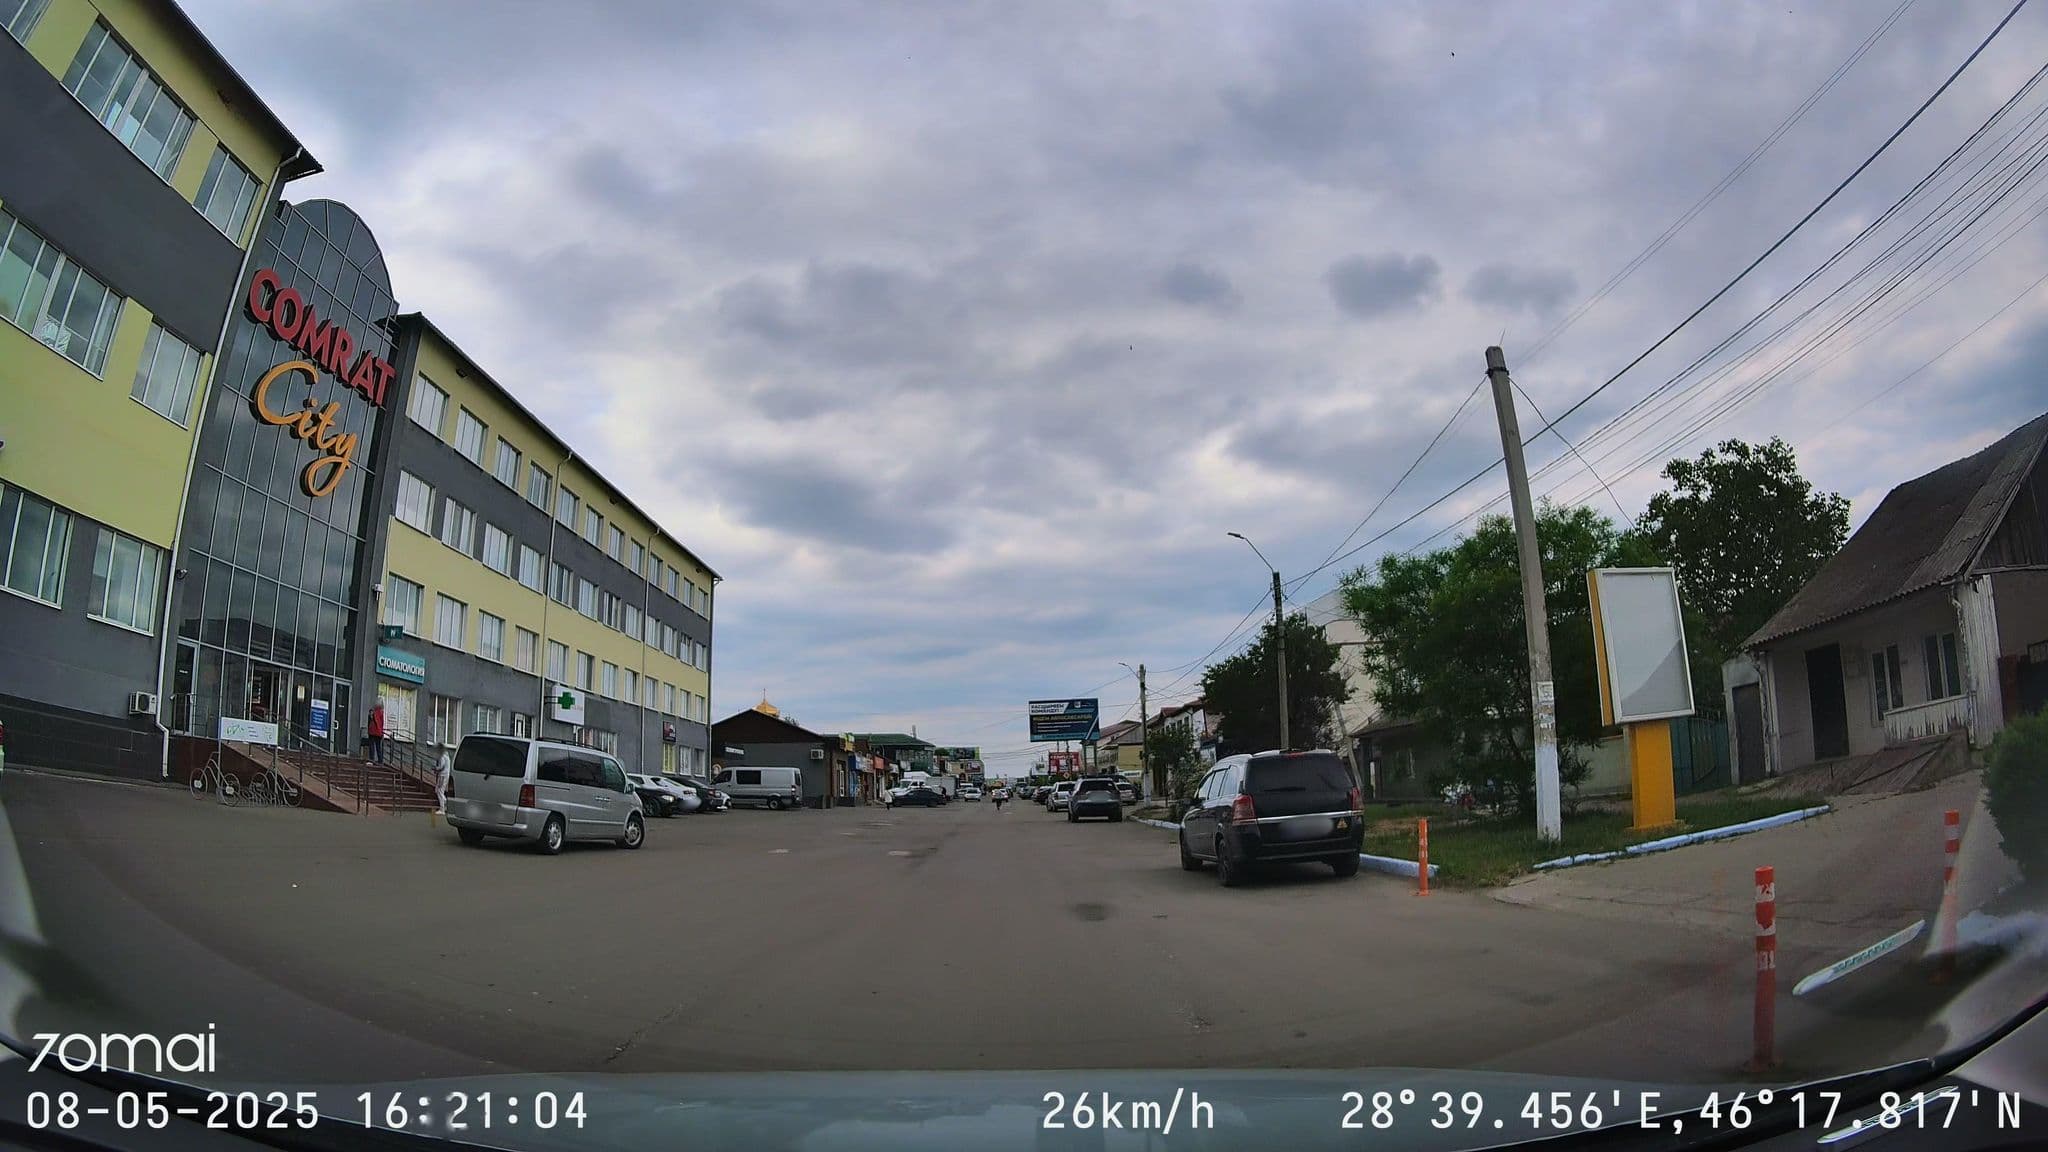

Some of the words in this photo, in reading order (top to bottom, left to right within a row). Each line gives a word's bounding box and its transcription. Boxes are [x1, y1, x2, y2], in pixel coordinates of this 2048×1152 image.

[249, 267, 396, 406] COMRAT
[256, 360, 357, 497] City
[379, 656, 425, 677] СТОМАТОЛОГИЯ
